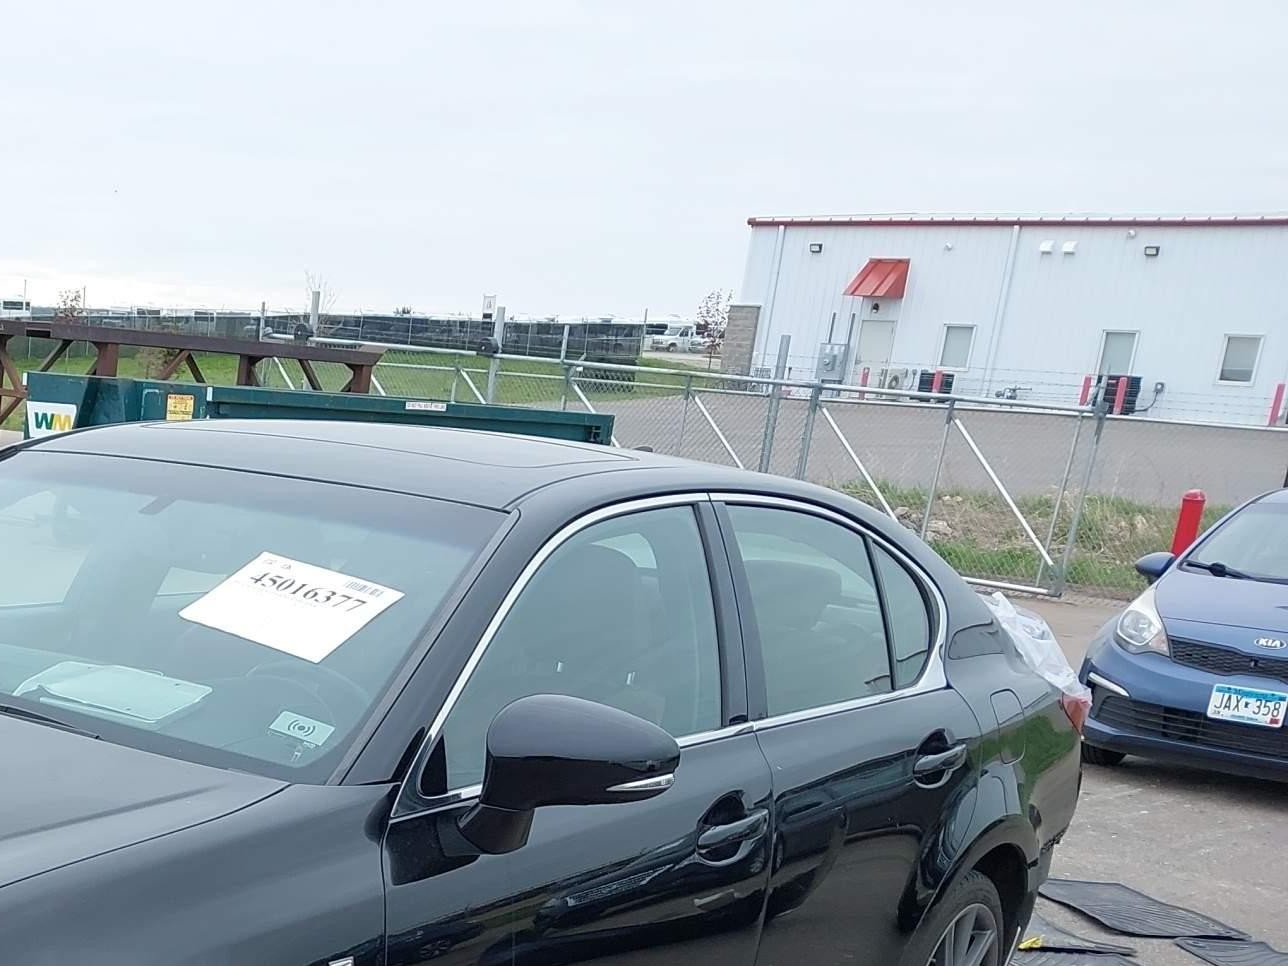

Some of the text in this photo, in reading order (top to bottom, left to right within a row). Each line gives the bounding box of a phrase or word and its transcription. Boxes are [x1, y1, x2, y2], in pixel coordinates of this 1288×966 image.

[34, 411, 72, 431] WM
[250, 572, 367, 612] 45016377
[1258, 638, 1281, 648] KIA
[1214, 694, 1244, 712] JAX
[1252, 699, 1281, 717] 358
